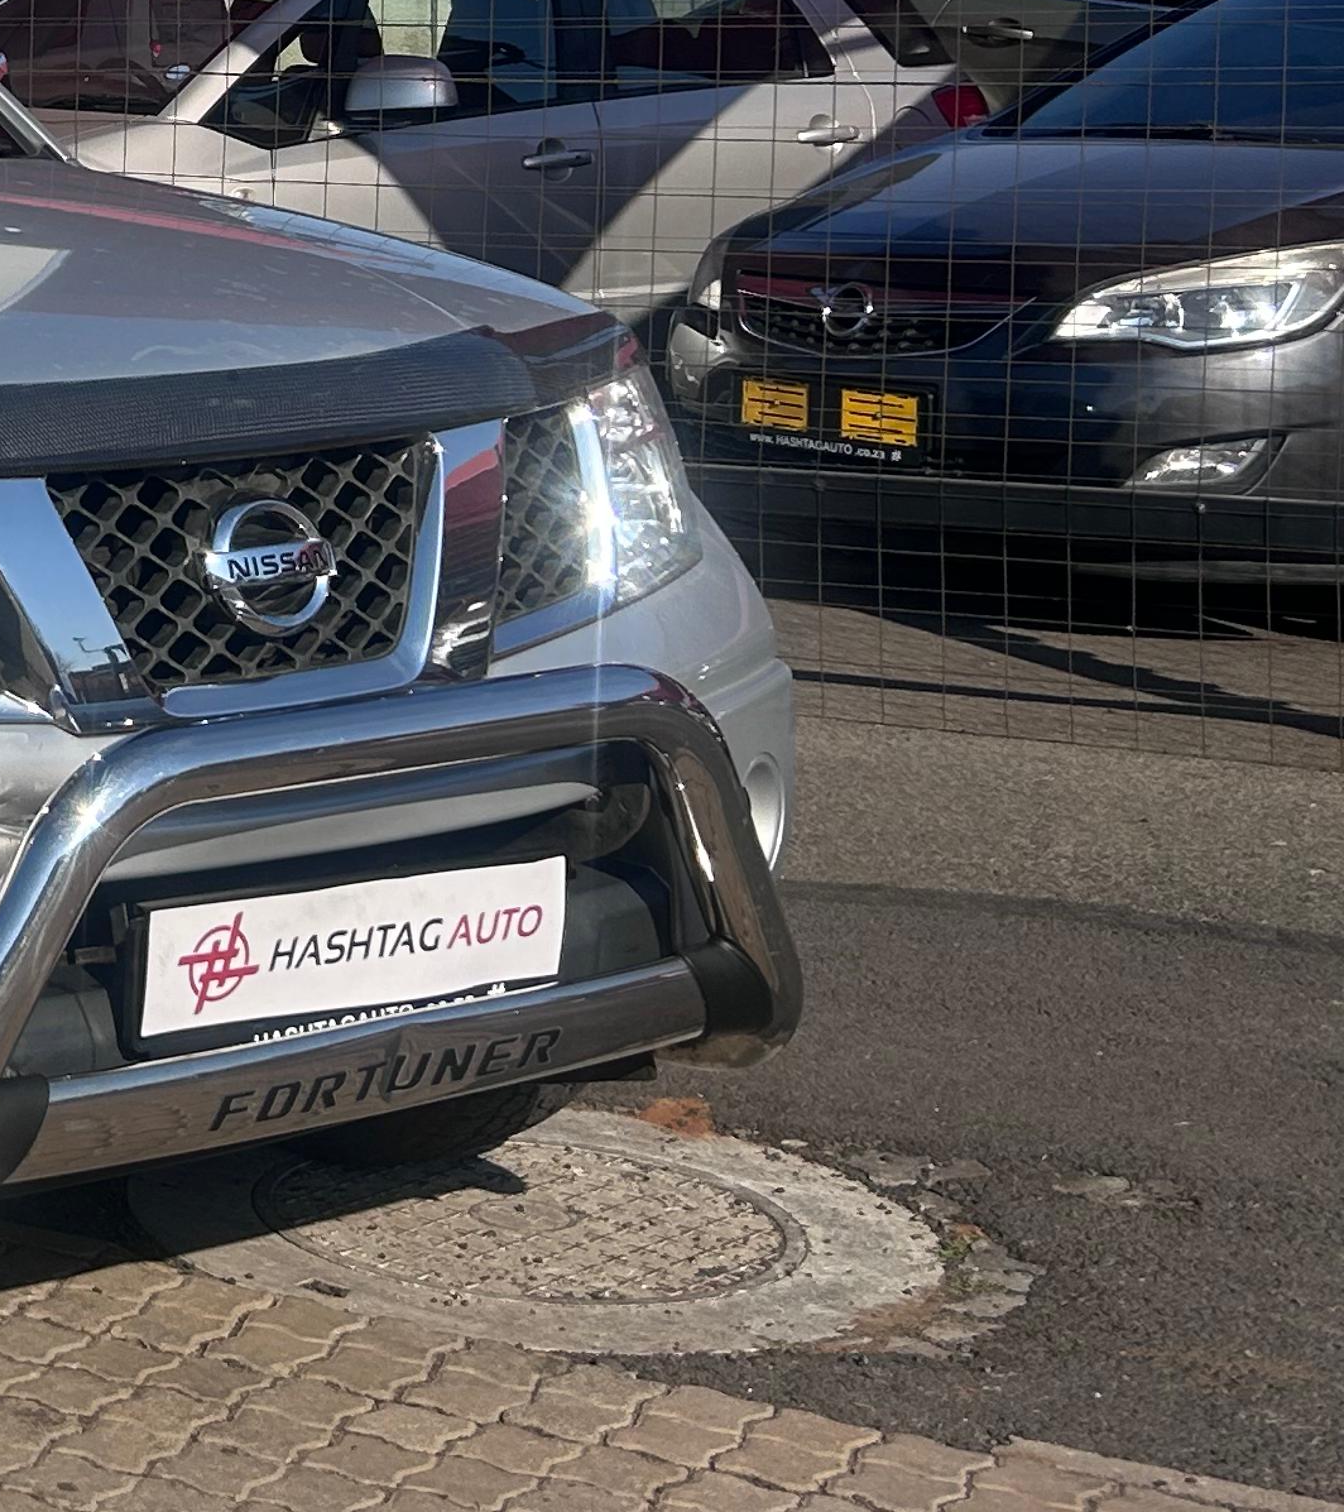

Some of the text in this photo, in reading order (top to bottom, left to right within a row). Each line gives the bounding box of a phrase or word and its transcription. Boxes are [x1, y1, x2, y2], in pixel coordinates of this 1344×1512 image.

[227, 550, 328, 578] NISSAN
[268, 905, 543, 971] HASHTAG AUTO
[208, 1027, 563, 1131] FORTUNER
